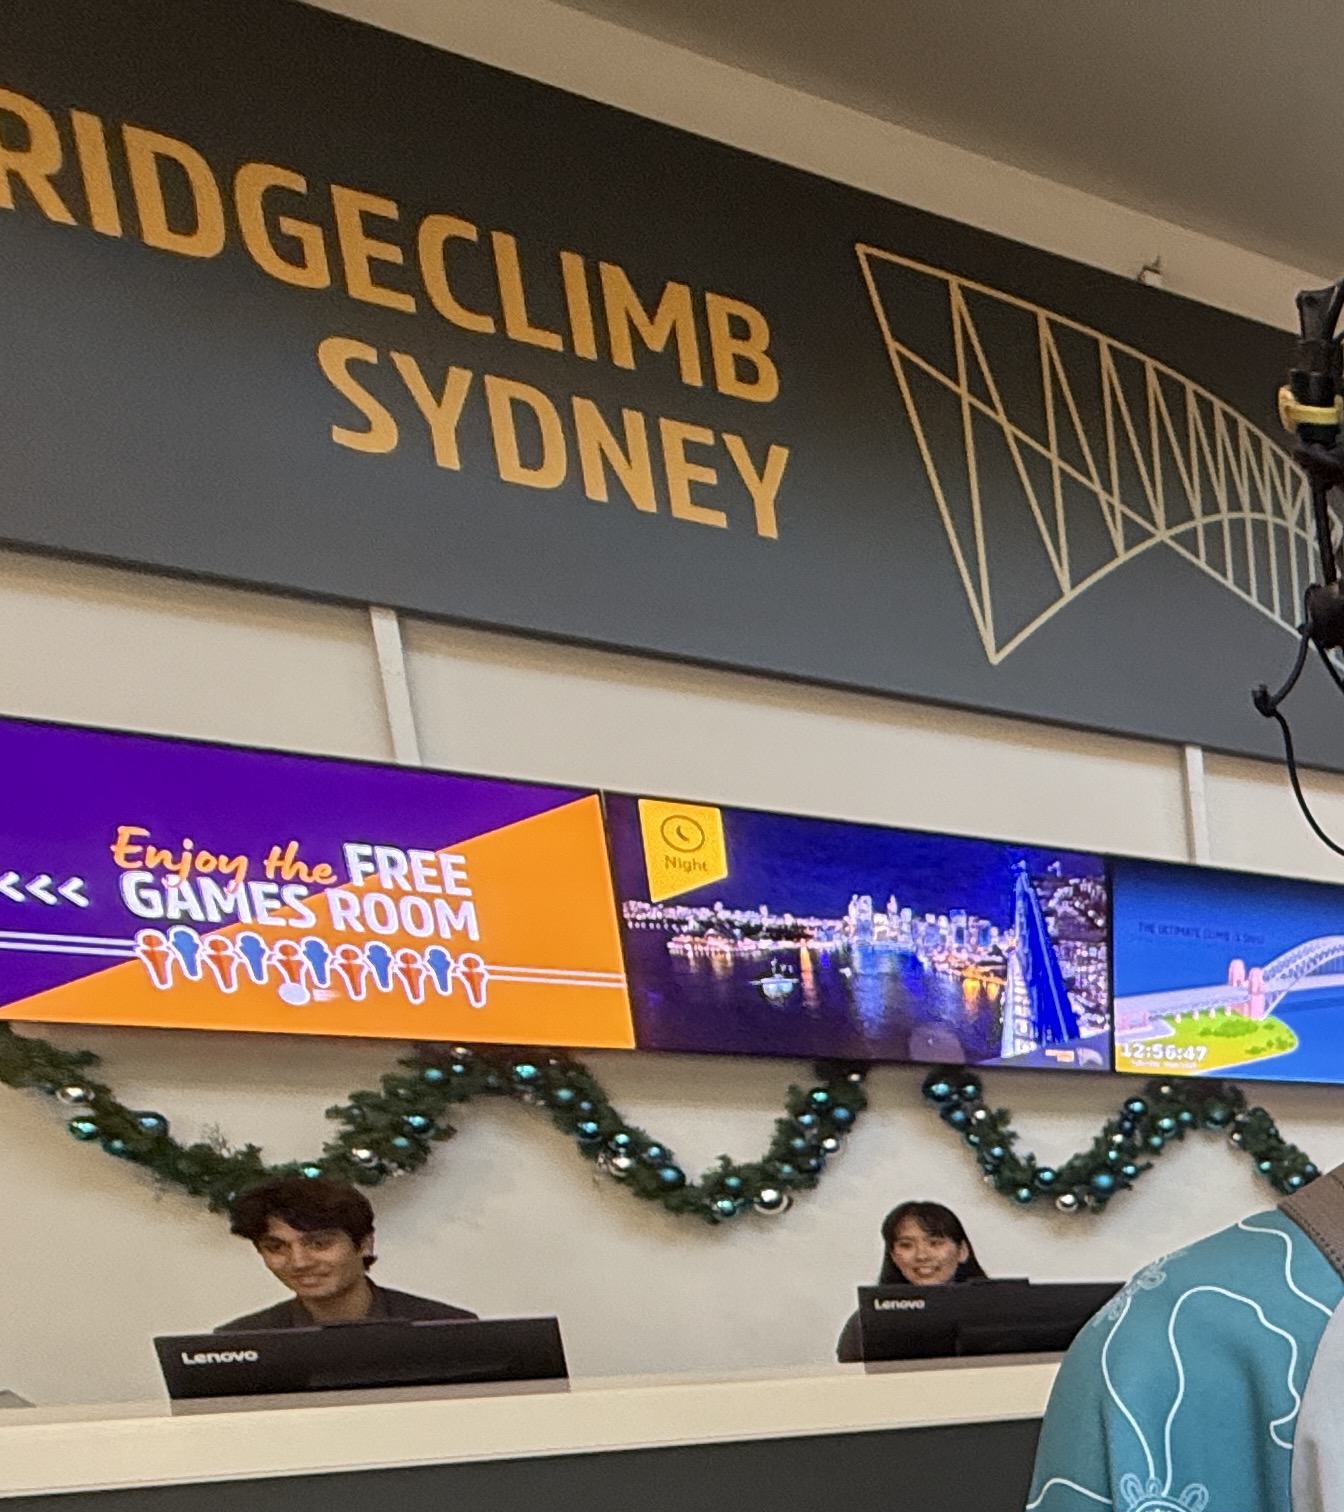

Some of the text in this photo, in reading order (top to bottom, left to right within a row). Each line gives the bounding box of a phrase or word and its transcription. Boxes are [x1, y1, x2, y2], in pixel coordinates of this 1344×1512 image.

[0, 89, 780, 403] RIDGECLIMB
[316, 336, 789, 540] SYDNEY
[110, 825, 473, 897] Enjoy the FREE
[665, 855, 708, 874] Night
[120, 870, 480, 941] GAMES ROOM
[1121, 1043, 1207, 1061] 12:56:47
[873, 1298, 926, 1311] Lenovo
[181, 1350, 259, 1366] Lenovo
